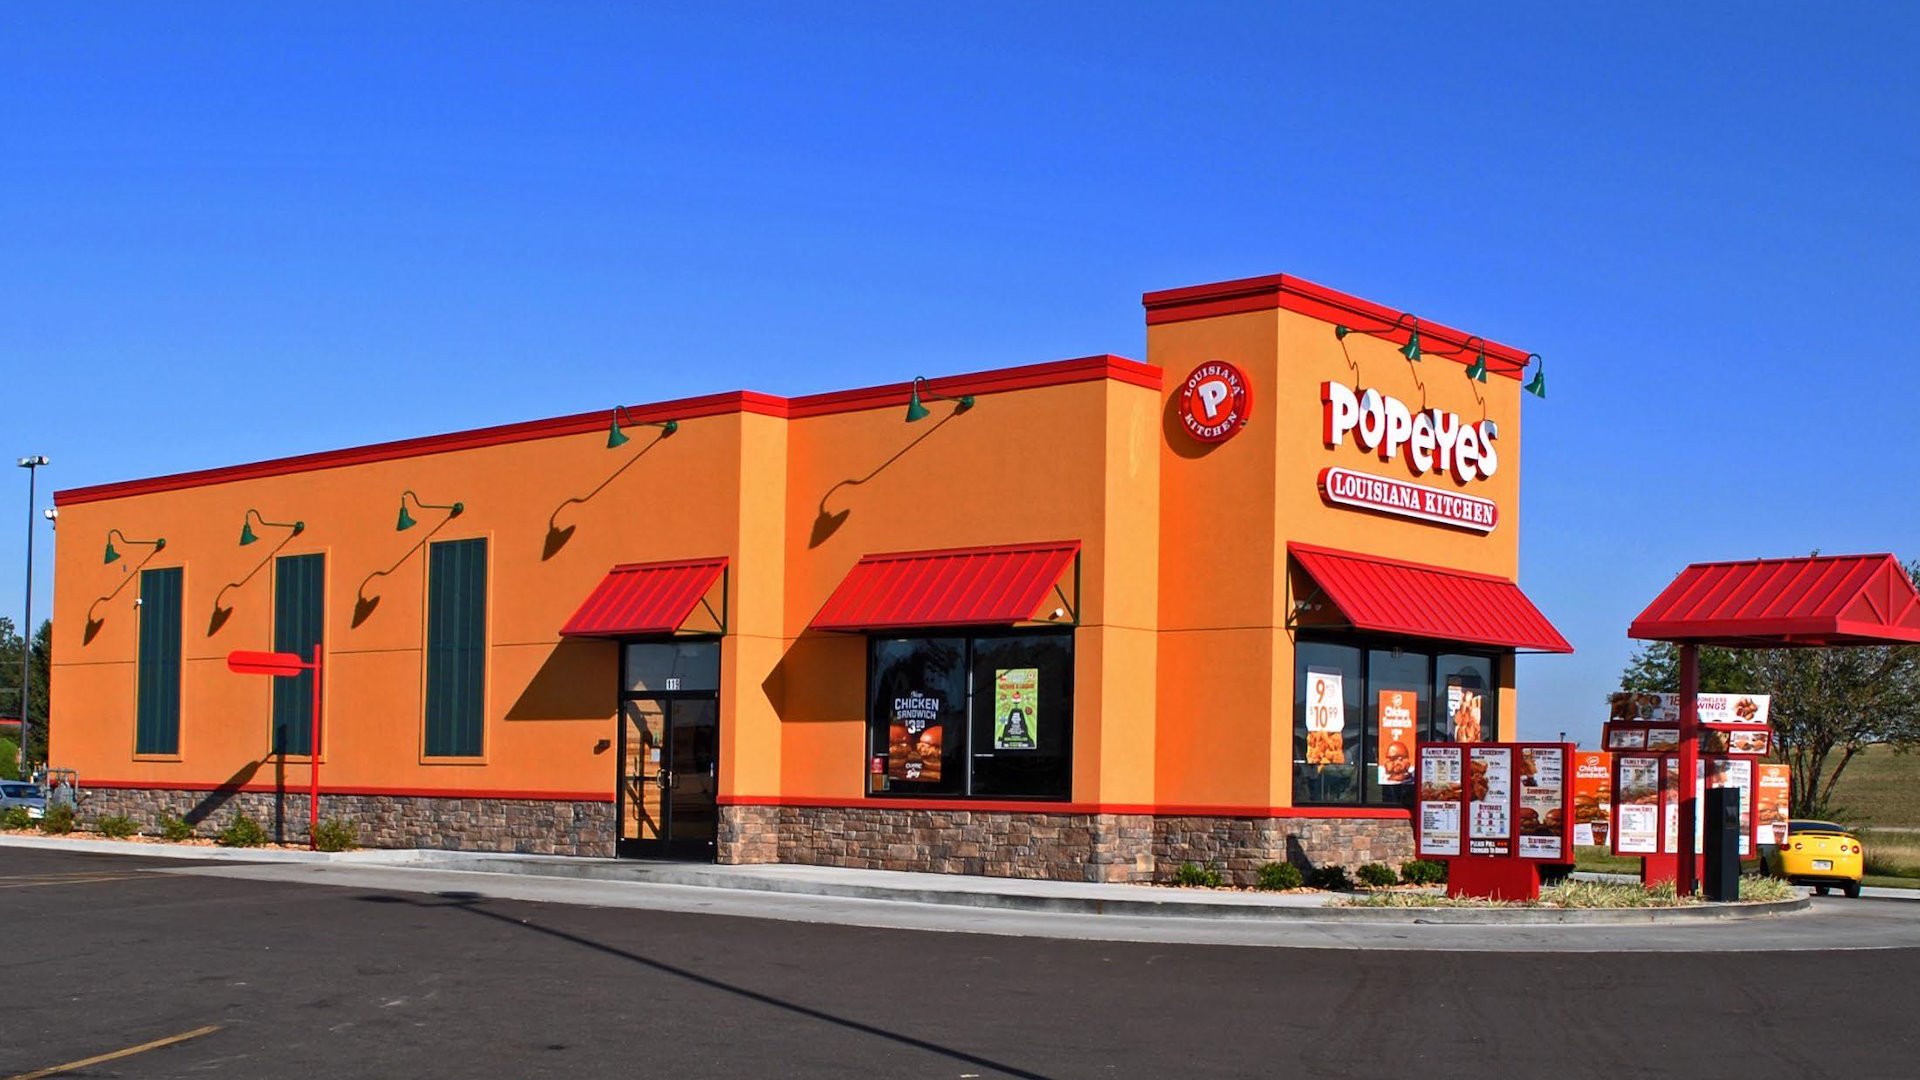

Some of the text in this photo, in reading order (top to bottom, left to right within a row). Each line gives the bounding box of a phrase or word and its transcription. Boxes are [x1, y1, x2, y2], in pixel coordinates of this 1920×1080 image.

[1184, 366, 1241, 398] LOUISIANA
[1198, 380, 1228, 419] P
[1184, 411, 1238, 437] KITCHEN
[1334, 473, 1495, 525] LOUISIANA KITCHEN
[1316, 679, 1325, 704] 9
[894, 698, 940, 711] CHICKEN
[896, 710, 937, 720] SANDWICH
[1697, 703, 1727, 711] WINGS
[1578, 764, 1607, 773] Chicken
